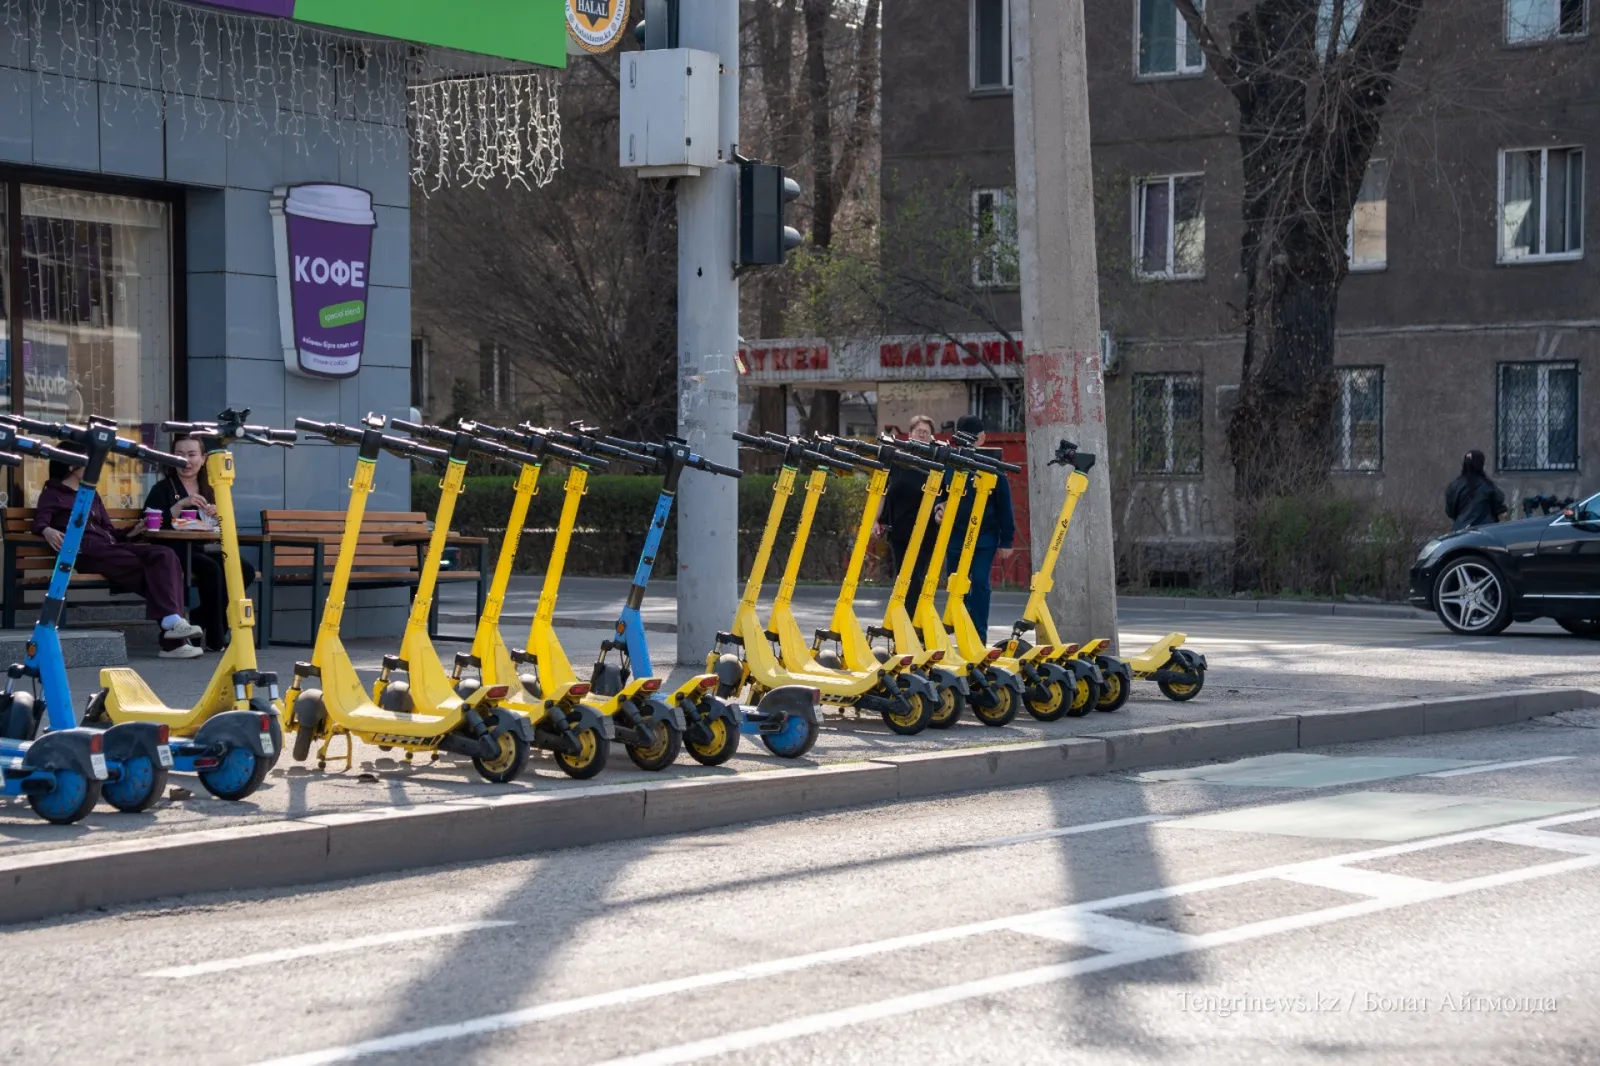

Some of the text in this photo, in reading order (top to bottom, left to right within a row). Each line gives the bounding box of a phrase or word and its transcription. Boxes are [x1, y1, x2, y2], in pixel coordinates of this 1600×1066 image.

[577, 0, 608, 16] HALAL
[295, 255, 365, 288] КОФЕ
[880, 340, 1024, 368] МАГАЗИН
